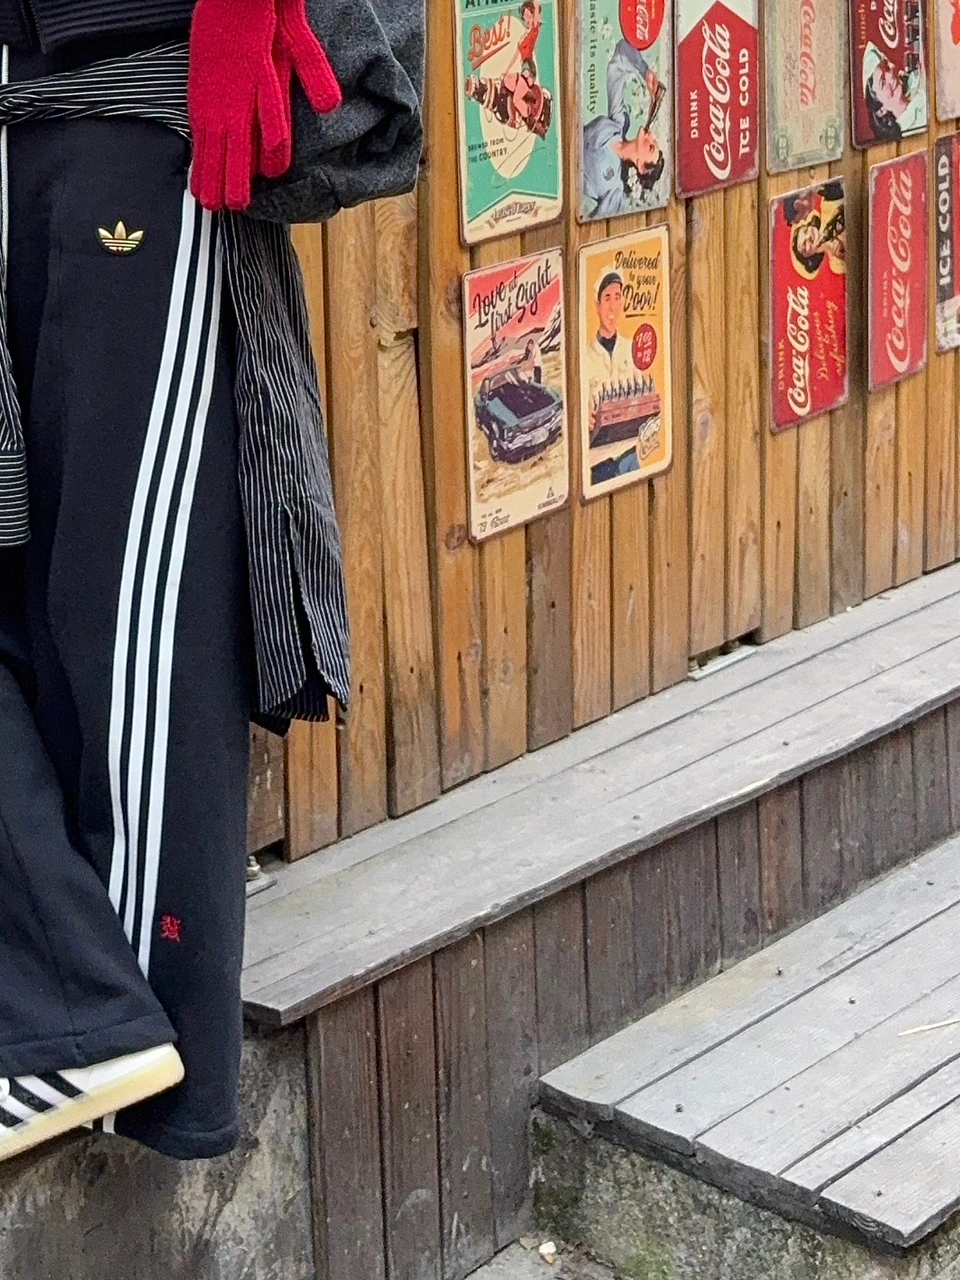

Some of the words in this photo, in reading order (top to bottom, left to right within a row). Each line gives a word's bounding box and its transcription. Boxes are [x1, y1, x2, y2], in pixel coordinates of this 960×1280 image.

[468, 9, 512, 62] Best!
[587, 64, 599, 114] quality
[702, 19, 732, 180] Coca-Cola
[739, 47, 749, 106] COLD
[690, 89, 699, 139] DRINK
[479, 148, 507, 161] COUNTRY
[490, 138, 504, 146] FROM
[939, 154, 949, 232] COLD
[615, 251, 660, 271] Delivered
[637, 273, 657, 289] your
[940, 240, 950, 286] ICE
[473, 282, 507, 331] Love
[509, 271, 518, 293] at
[516, 258, 551, 323] Sight
[623, 283, 660, 313] Door!
[787, 285, 811, 416] Coca-Cola
